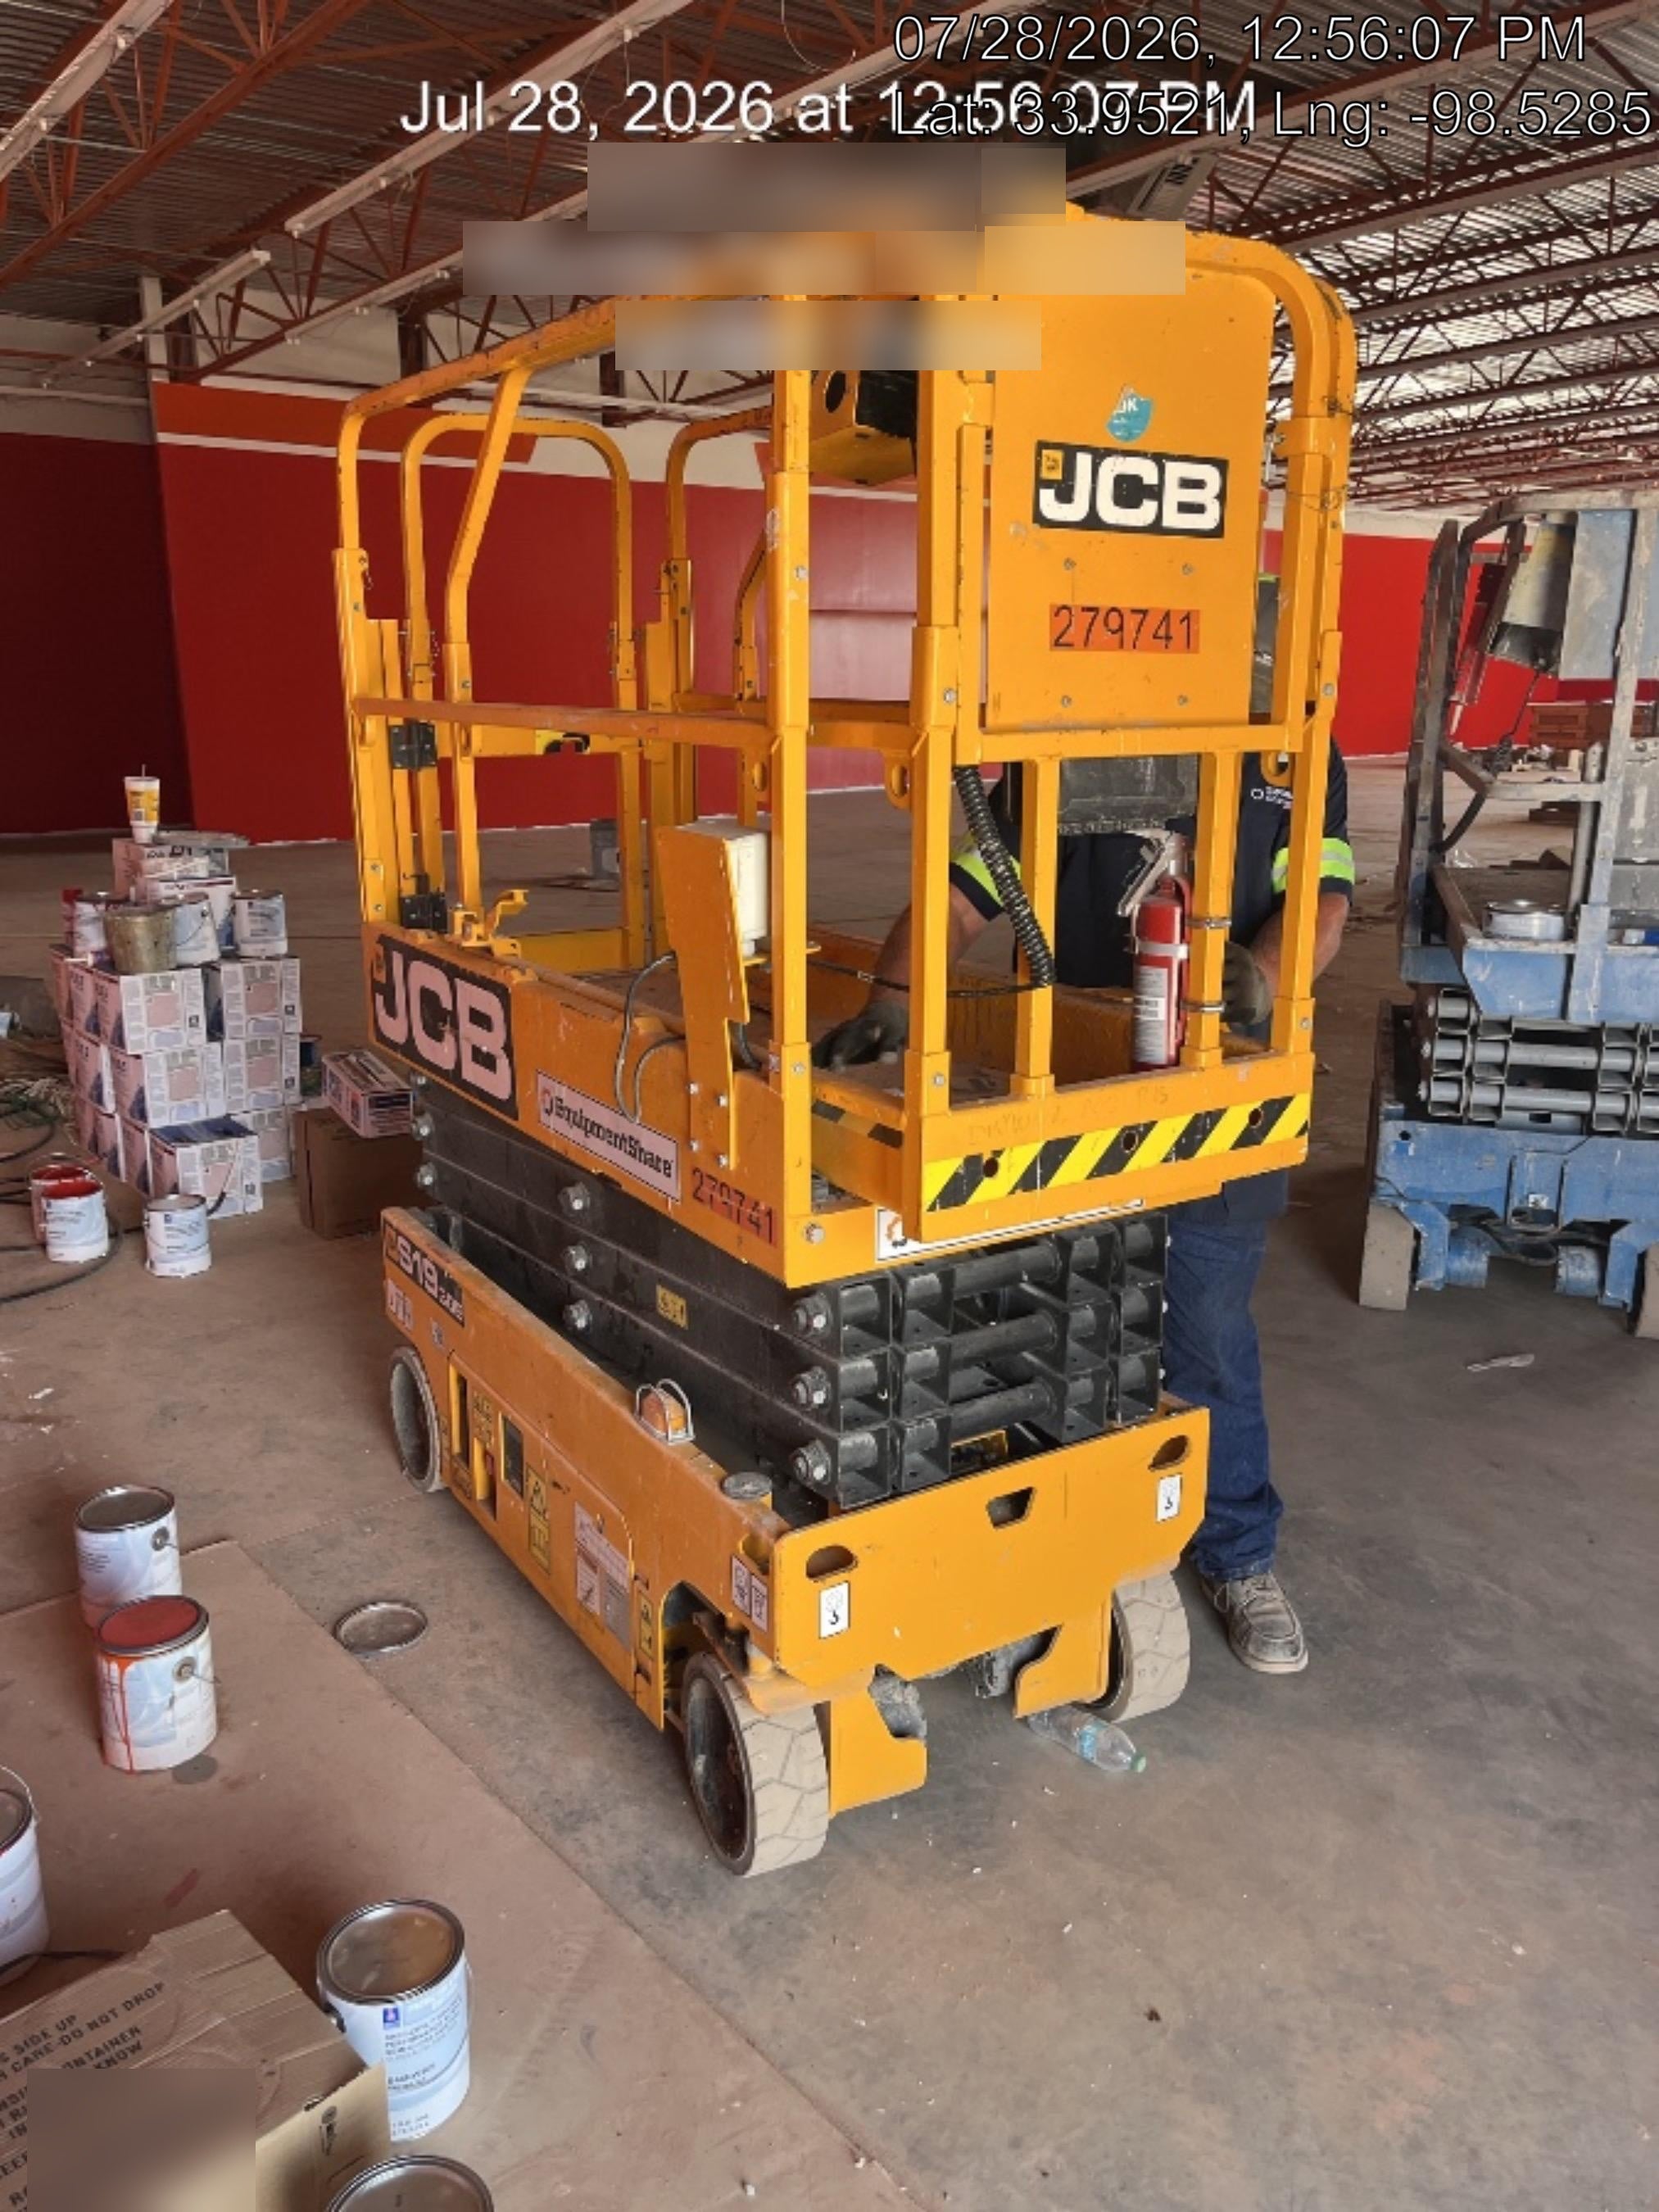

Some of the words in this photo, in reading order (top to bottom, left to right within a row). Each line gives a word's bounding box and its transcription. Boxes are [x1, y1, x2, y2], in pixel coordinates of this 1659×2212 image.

[1039, 451, 1222, 530] JCB
[1052, 604, 1194, 650] 279741
[375, 950, 512, 1099] JCB
[554, 1095, 673, 1178] EquipmentShare
[691, 1167, 774, 1244] 279741
